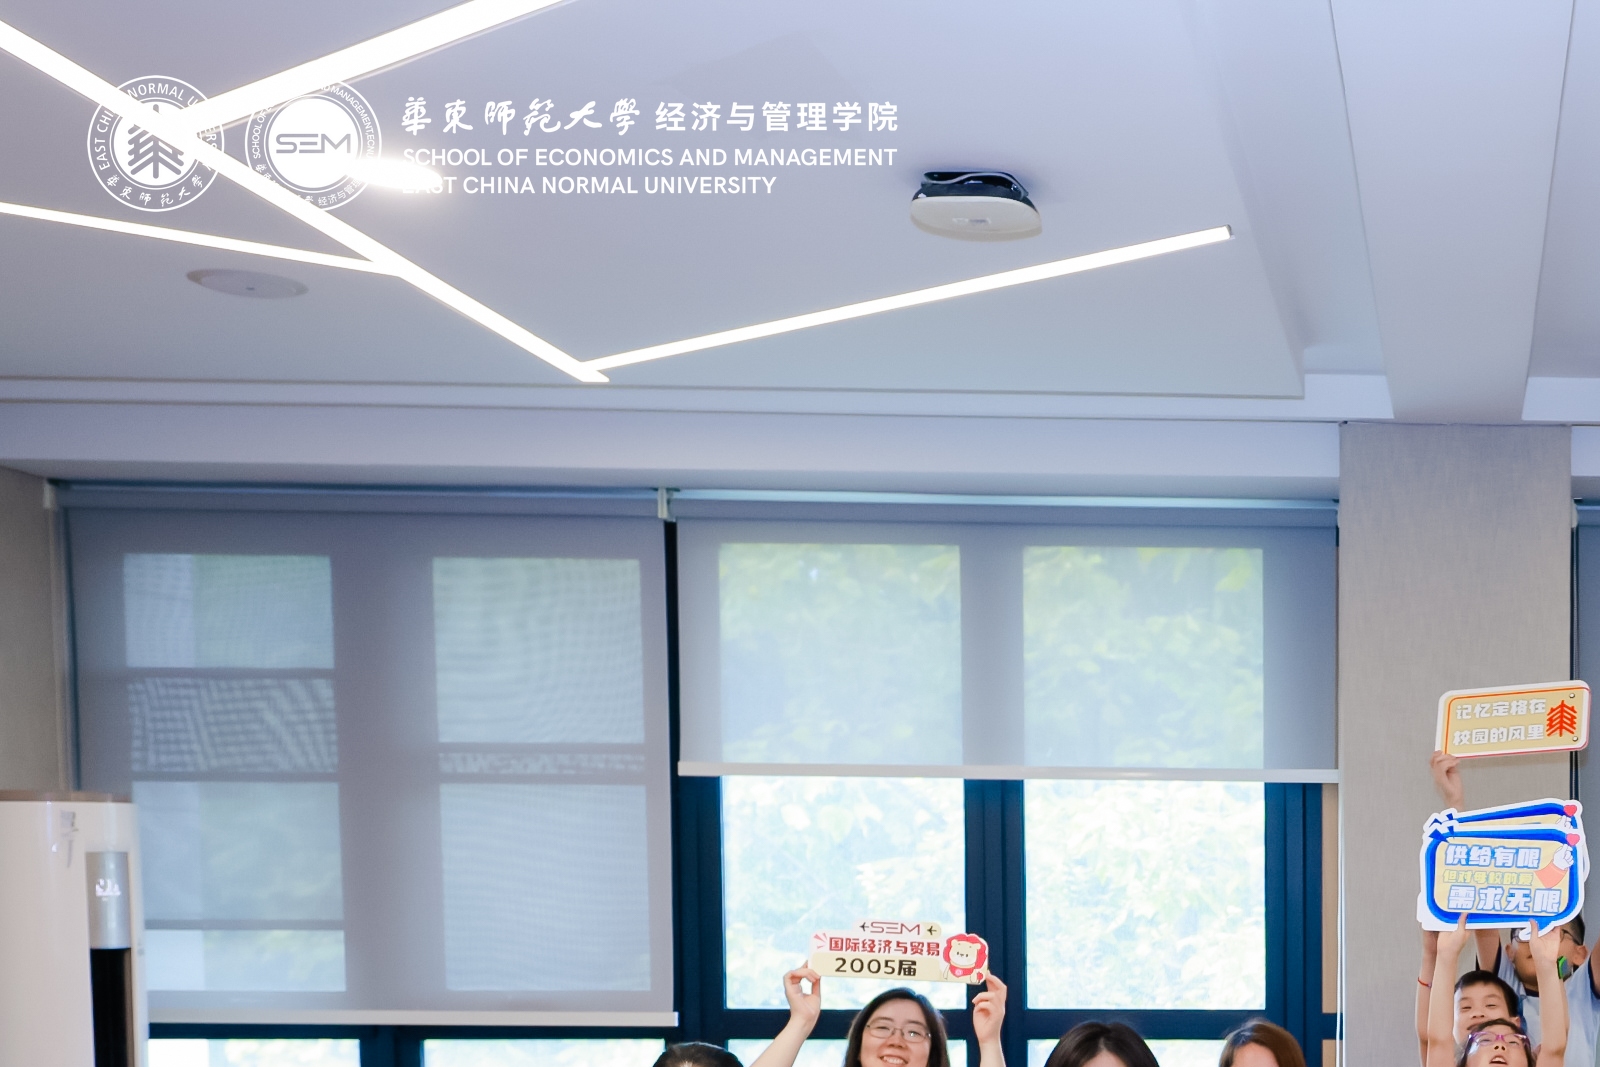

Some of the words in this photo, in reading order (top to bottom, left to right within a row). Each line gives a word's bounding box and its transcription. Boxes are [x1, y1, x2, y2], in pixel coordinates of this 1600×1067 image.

[1455, 699, 1547, 720] 记忆定格在
[1453, 724, 1545, 746] 校园的风里
[1444, 844, 1541, 869] 供给有限
[1442, 869, 1534, 887] 但对母校的爱
[1447, 884, 1563, 914] 需求无限
[869, 921, 921, 935] SEM
[828, 936, 941, 956] 国际经济与贸易
[834, 957, 917, 977] 2005届
